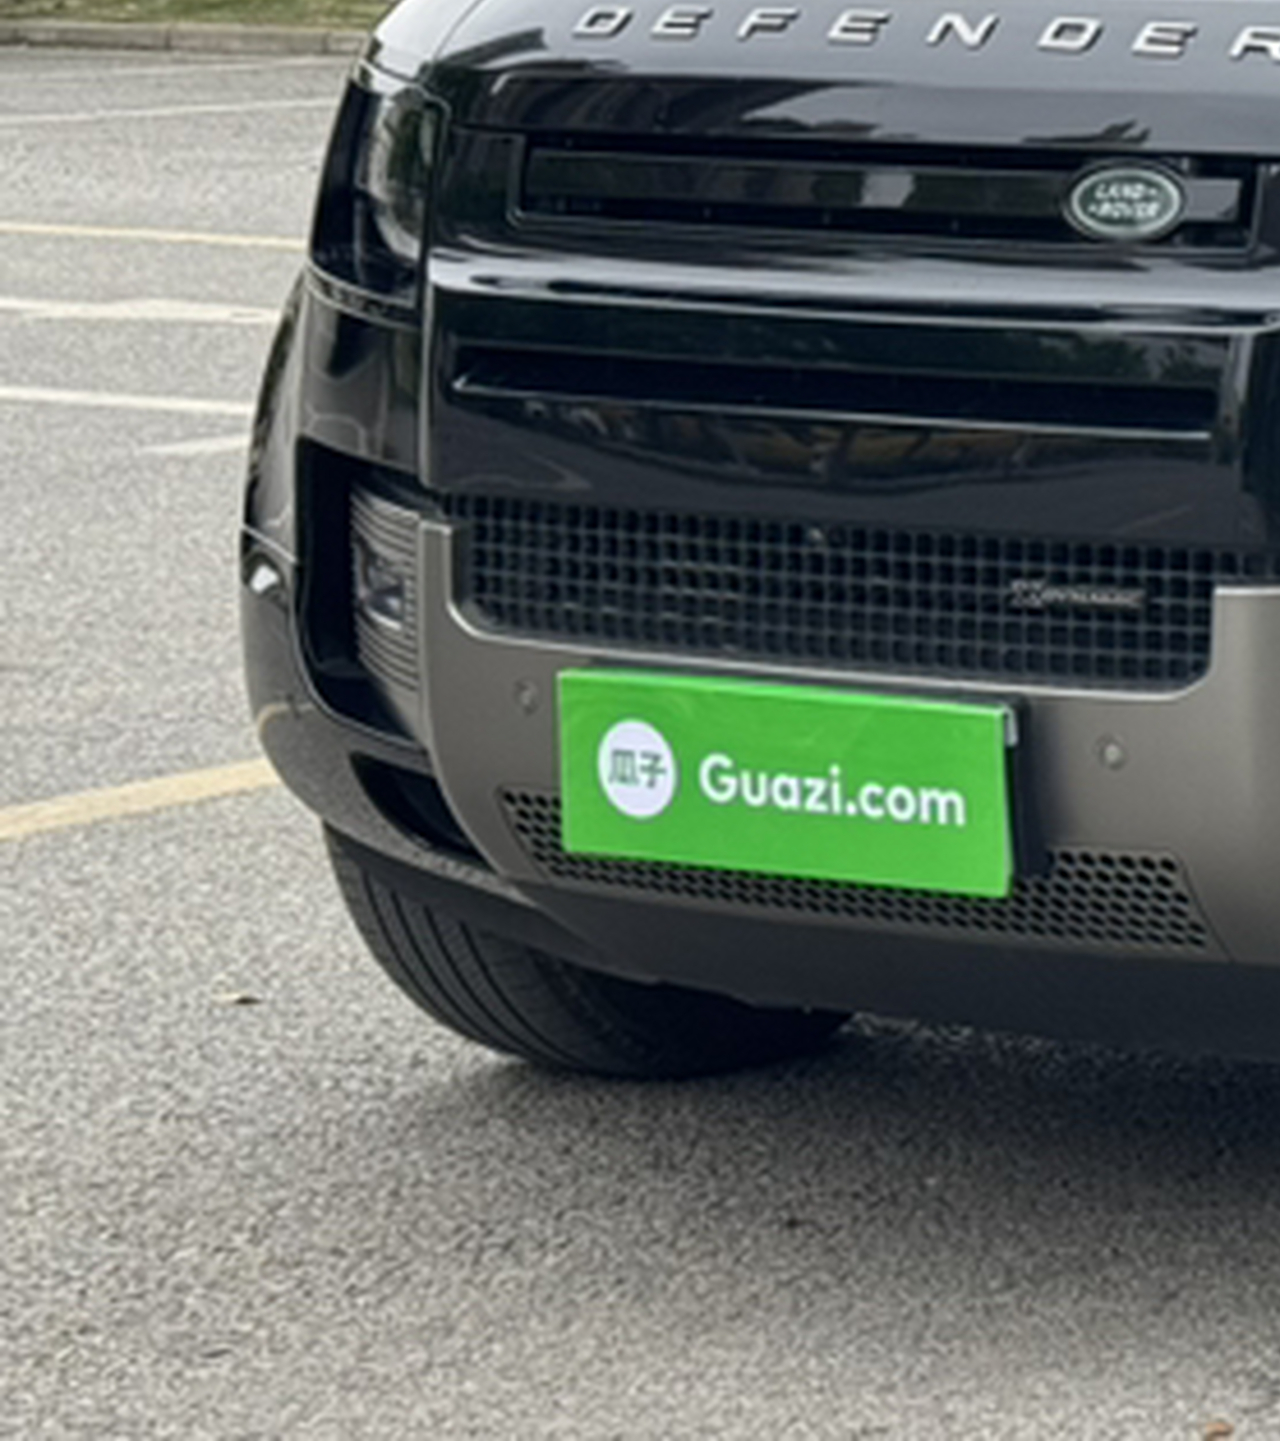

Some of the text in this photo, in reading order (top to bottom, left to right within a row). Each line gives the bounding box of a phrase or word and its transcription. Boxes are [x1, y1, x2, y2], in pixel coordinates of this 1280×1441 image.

[1093, 182, 1145, 200] LAND
[607, 748, 668, 790] 瓜子
[698, 753, 966, 827] Guazi.com
